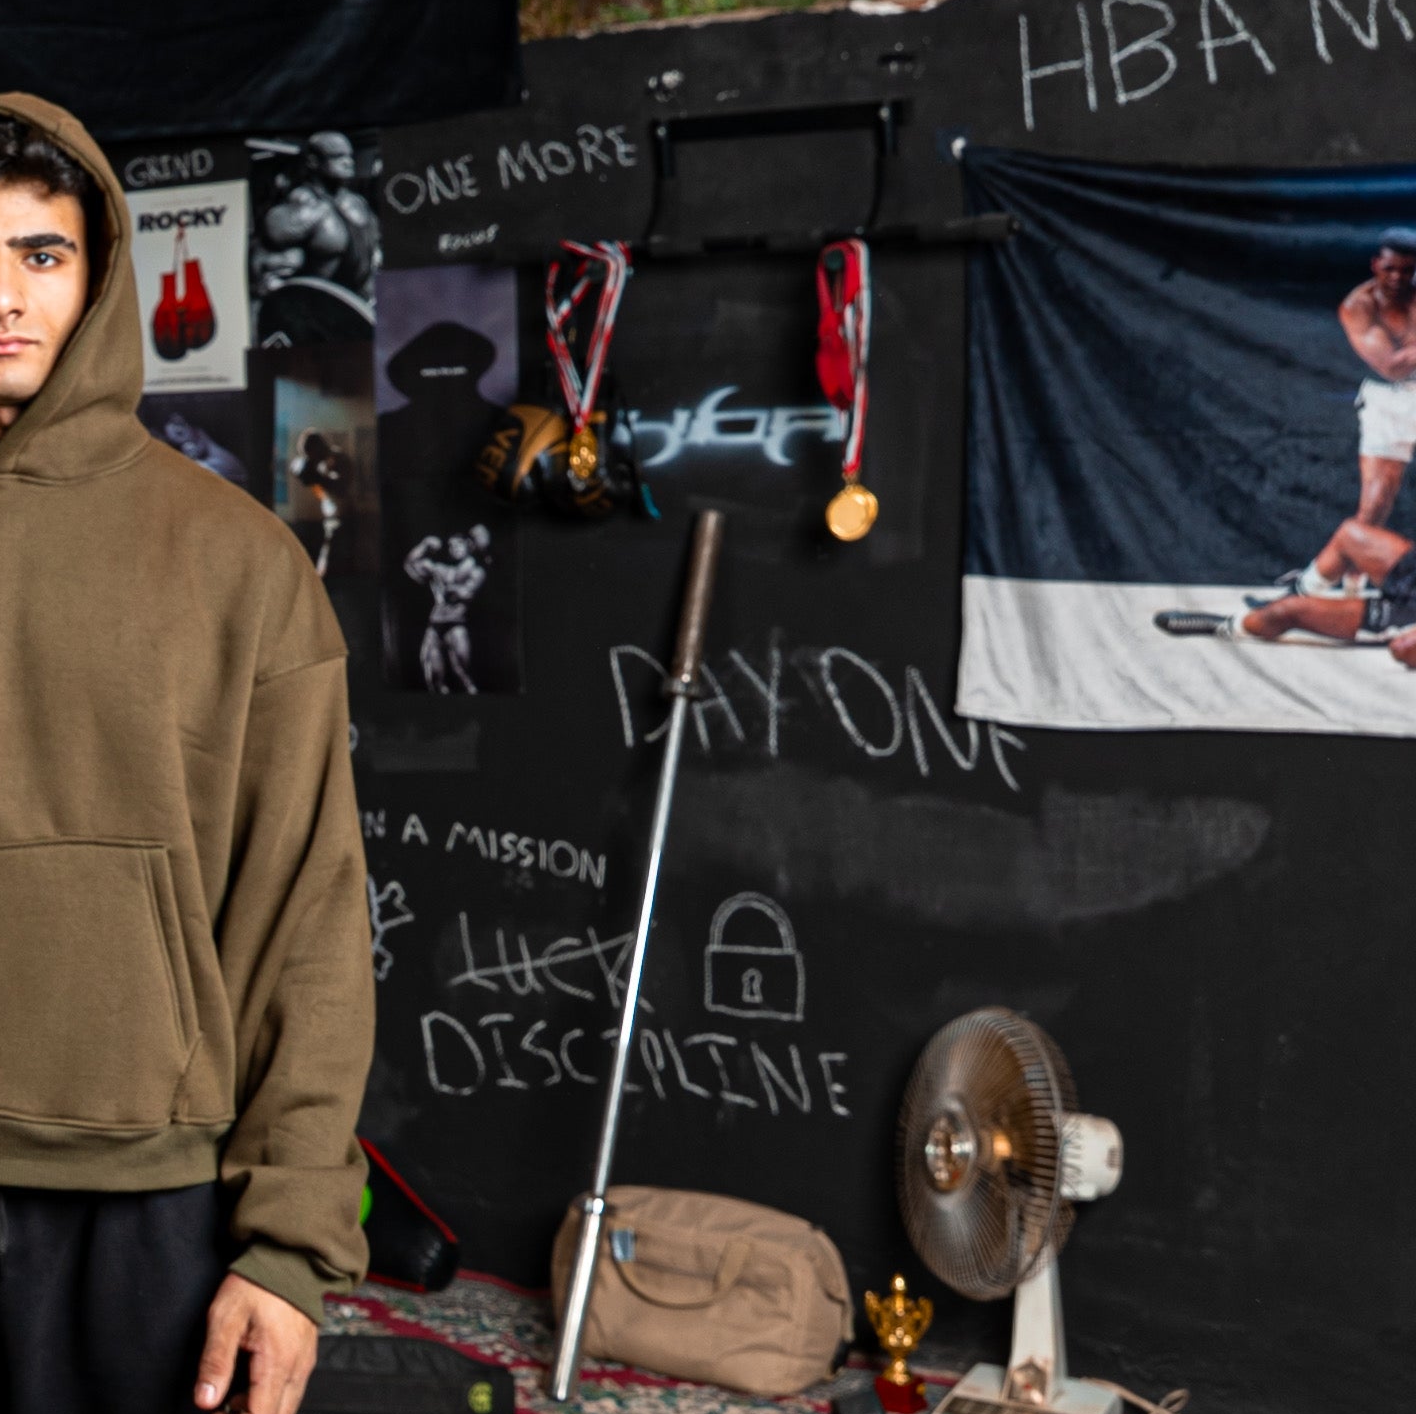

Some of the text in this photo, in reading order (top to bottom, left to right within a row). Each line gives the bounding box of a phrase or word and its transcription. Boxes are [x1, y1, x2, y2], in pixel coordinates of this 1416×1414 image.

[124, 148, 215, 188] GRIND
[385, 124, 637, 214] ONE MORE
[138, 205, 227, 233] ROCKY
[401, 813, 428, 845] A
[445, 821, 606, 888] MISSION
